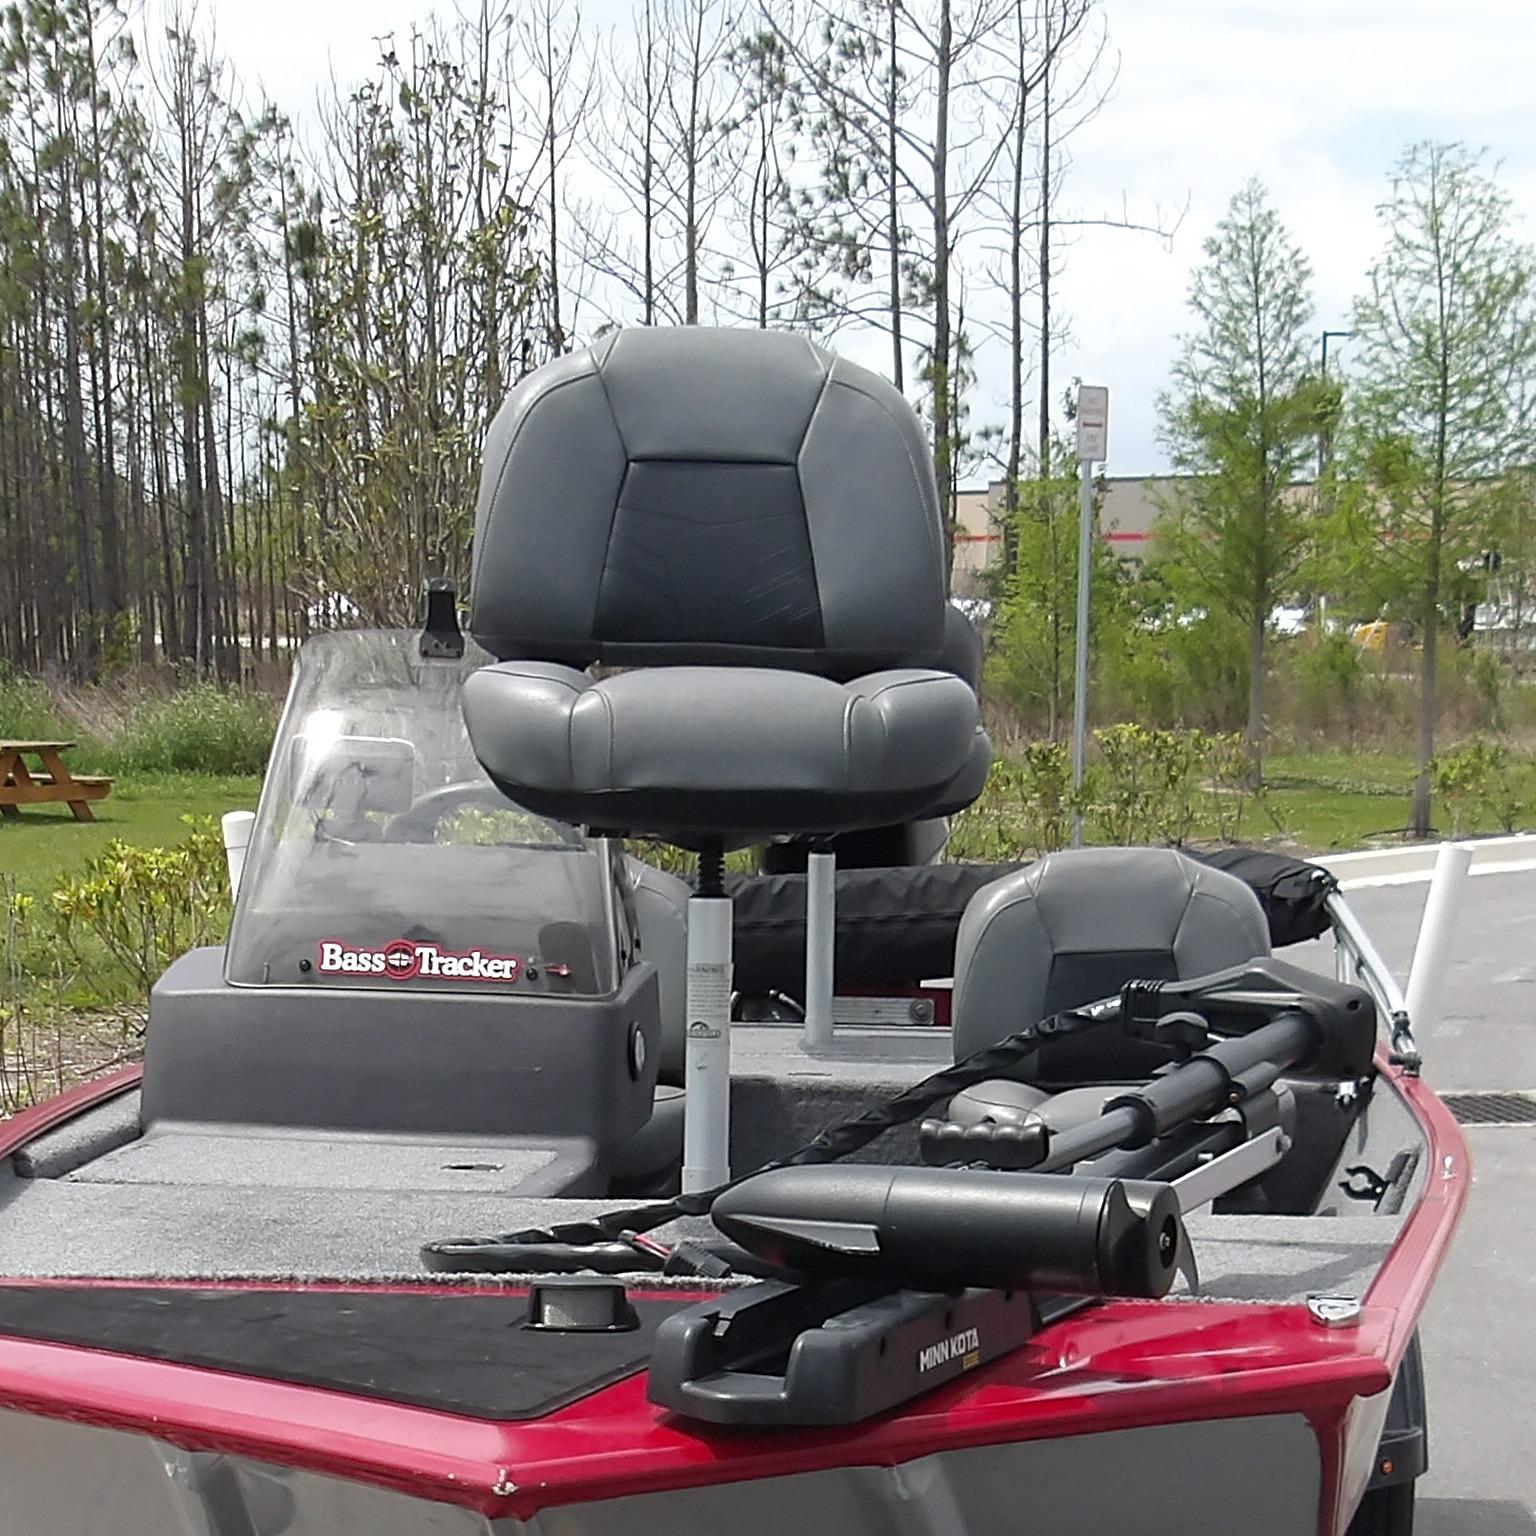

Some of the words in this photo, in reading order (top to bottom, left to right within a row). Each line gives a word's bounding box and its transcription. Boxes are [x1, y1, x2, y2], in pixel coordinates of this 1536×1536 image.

[320, 943, 386, 972] Bass
[415, 947, 518, 980] Tracker
[919, 1339, 950, 1373] MINN
[950, 1327, 980, 1359] KOTA
